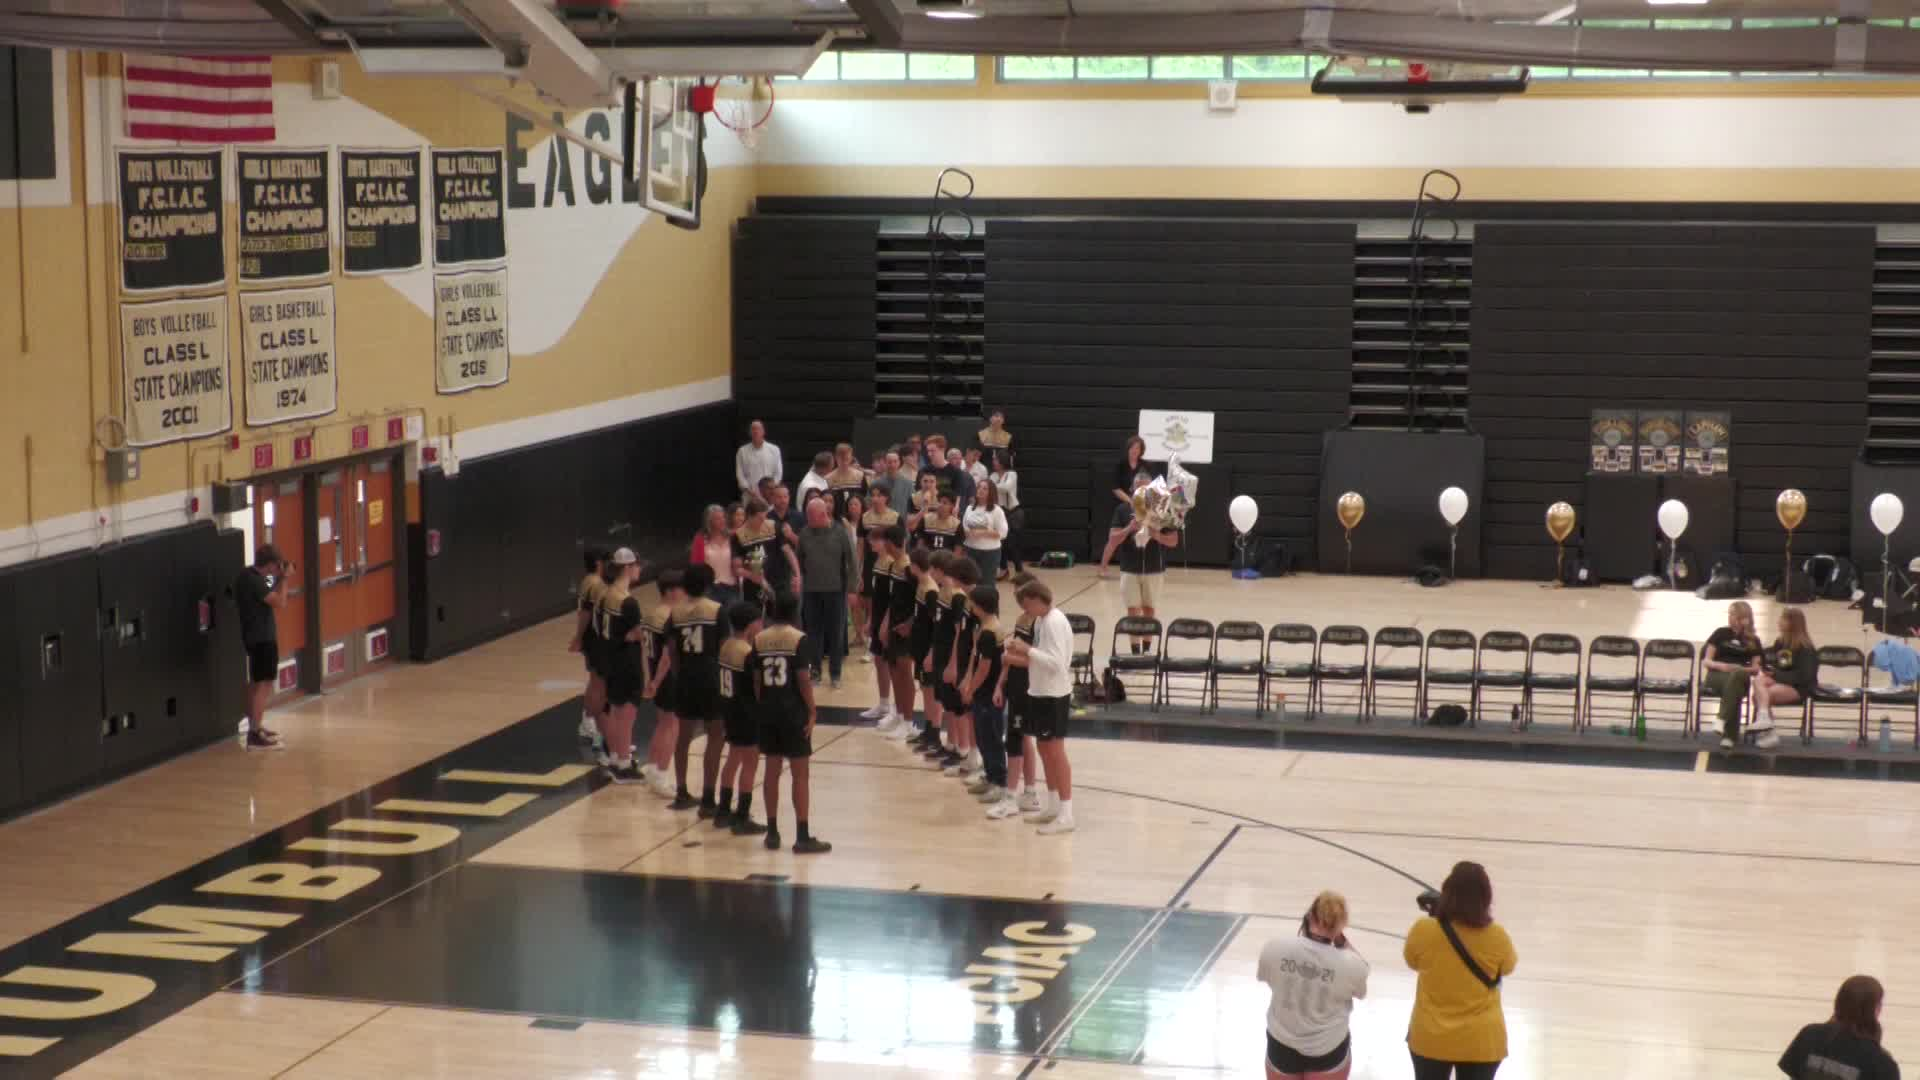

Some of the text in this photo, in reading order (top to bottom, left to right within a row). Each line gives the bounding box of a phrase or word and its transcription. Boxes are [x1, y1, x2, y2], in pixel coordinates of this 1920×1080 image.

[133, 311, 217, 337] BOYS VOLLEYBALL
[249, 300, 327, 324] GIRLS BASKETBALL
[446, 306, 481, 326] CLASS
[260, 328, 318, 351] CLASS L
[465, 327, 504, 352] CHAMPIONS
[143, 342, 210, 366] CLASS L
[251, 352, 329, 384] STATE CHAMPIONS
[133, 367, 223, 402] STATE CHAMPIONS
[276, 389, 307, 409] 1974
[763, 657, 787, 687] 23
[0, 763, 598, 1057] UMBULL
[1279, 957, 1296, 974] 20
